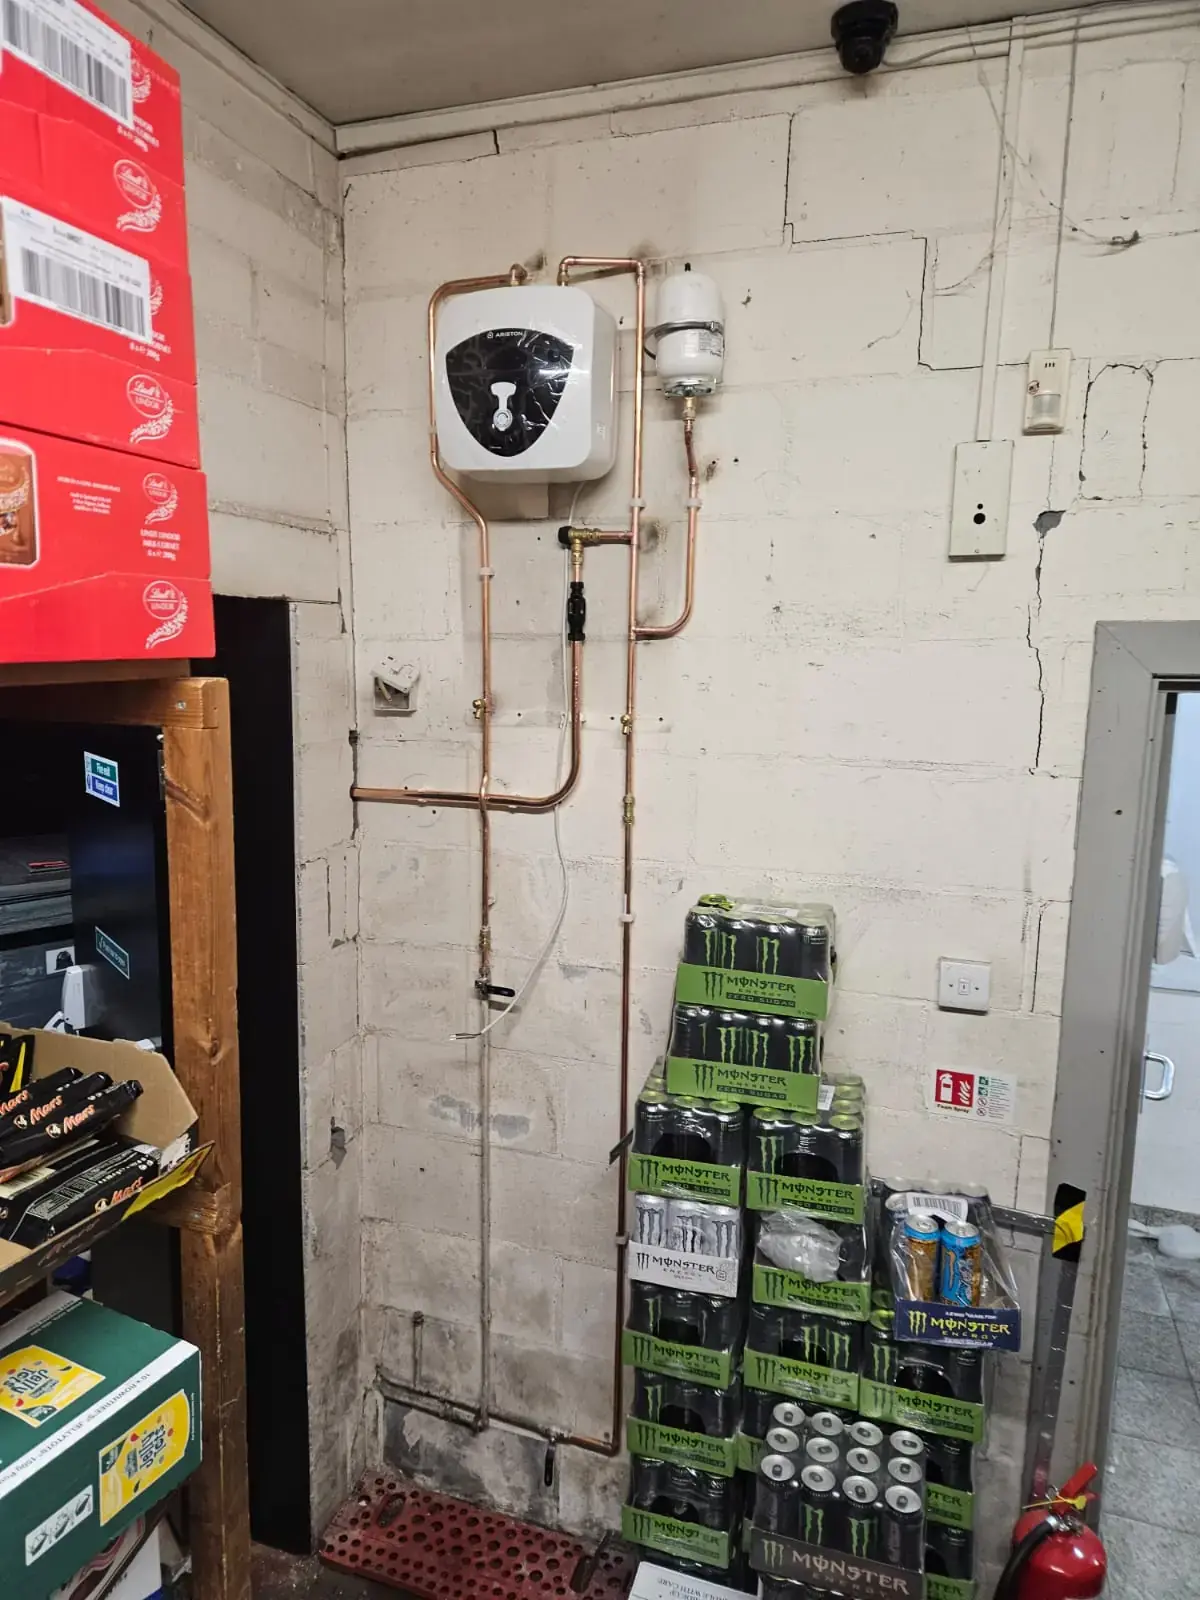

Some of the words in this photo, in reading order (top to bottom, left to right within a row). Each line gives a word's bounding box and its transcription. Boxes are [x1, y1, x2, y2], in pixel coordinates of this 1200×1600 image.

[727, 976, 796, 993] MONSTER
[738, 988, 782, 997] ENERGY
[727, 992, 755, 1002] ZERO
[759, 997, 795, 1007] SUGAR
[717, 1069, 787, 1086] MONSTER
[729, 1081, 773, 1091] ENERGY
[718, 1085, 746, 1094] ZERO
[749, 1090, 786, 1100] SUGAR
[30, 1095, 63, 1125] Mars
[63, 1104, 96, 1134] Mars
[662, 1164, 731, 1182] MONSTER
[782, 1182, 855, 1200] MONSTER
[815, 1203, 855, 1214] SUGAR
[653, 1256, 716, 1275] MONSTER
[788, 1278, 861, 1298] MONSTER
[930, 1317, 1011, 1335] MONSTER
[942, 1330, 999, 1340] ENERGY
[654, 1344, 720, 1367] MONSTER
[11, 1369, 49, 1394] Jelly
[780, 1364, 851, 1388] MONSTER
[898, 1394, 974, 1419] MONSTER
[139, 1431, 156, 1469] Jelly
[660, 1431, 726, 1455] MONSTER
[654, 1520, 720, 1546] MONSTER
[792, 1550, 910, 1595] MONSTER
[812, 1573, 888, 1598] ENERGY
